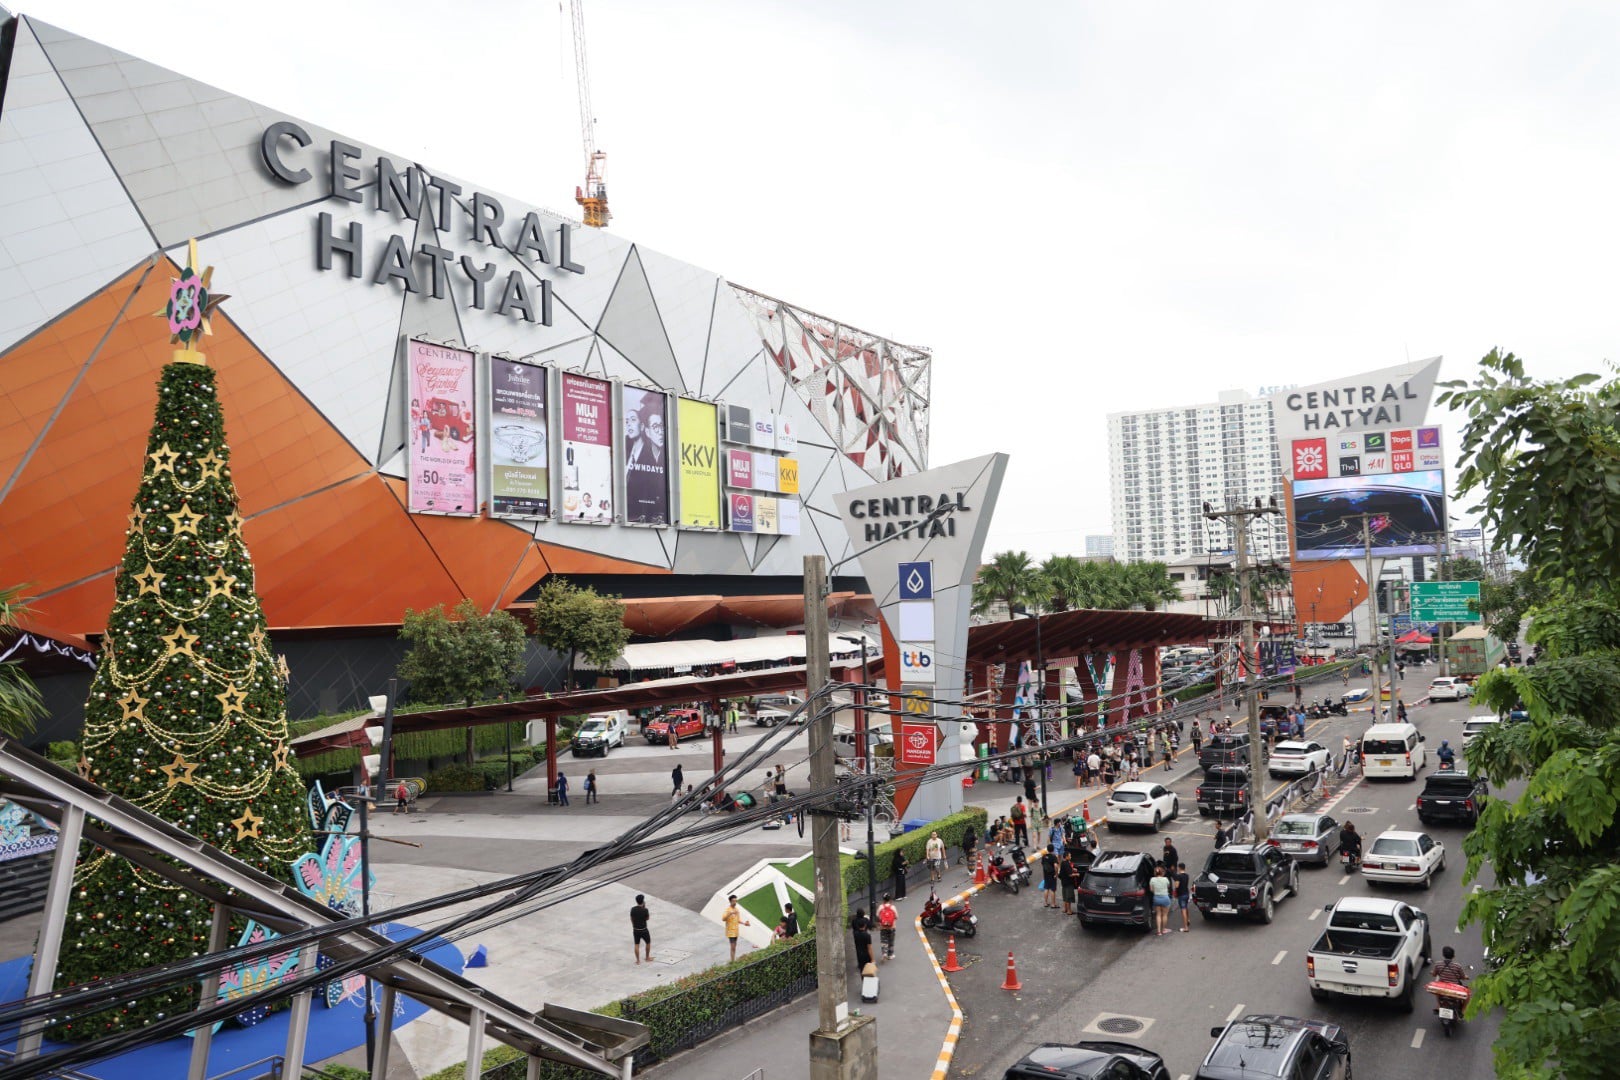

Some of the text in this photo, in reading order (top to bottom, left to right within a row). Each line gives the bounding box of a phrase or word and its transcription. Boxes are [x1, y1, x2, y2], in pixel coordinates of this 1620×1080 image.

[261, 121, 585, 274] CENTRAL
[317, 212, 552, 326] HATYAI
[418, 346, 464, 362] CENTRAL
[1286, 381, 1417, 411] CENTRAL
[575, 402, 598, 419] MUJI
[1304, 405, 1401, 430] HATYAI
[1341, 441, 1356, 449] B2S
[1392, 436, 1412, 444] Tops
[681, 442, 715, 469] KKV
[1393, 454, 1410, 462] UNI
[628, 463, 664, 474] OWNDAYS
[733, 458, 750, 472] MUJI
[1393, 462, 1411, 471] QLO
[780, 468, 797, 482] KKV
[849, 492, 971, 519] CENTRAL
[864, 518, 955, 542] HATYAI
[903, 651, 931, 668] ttb
